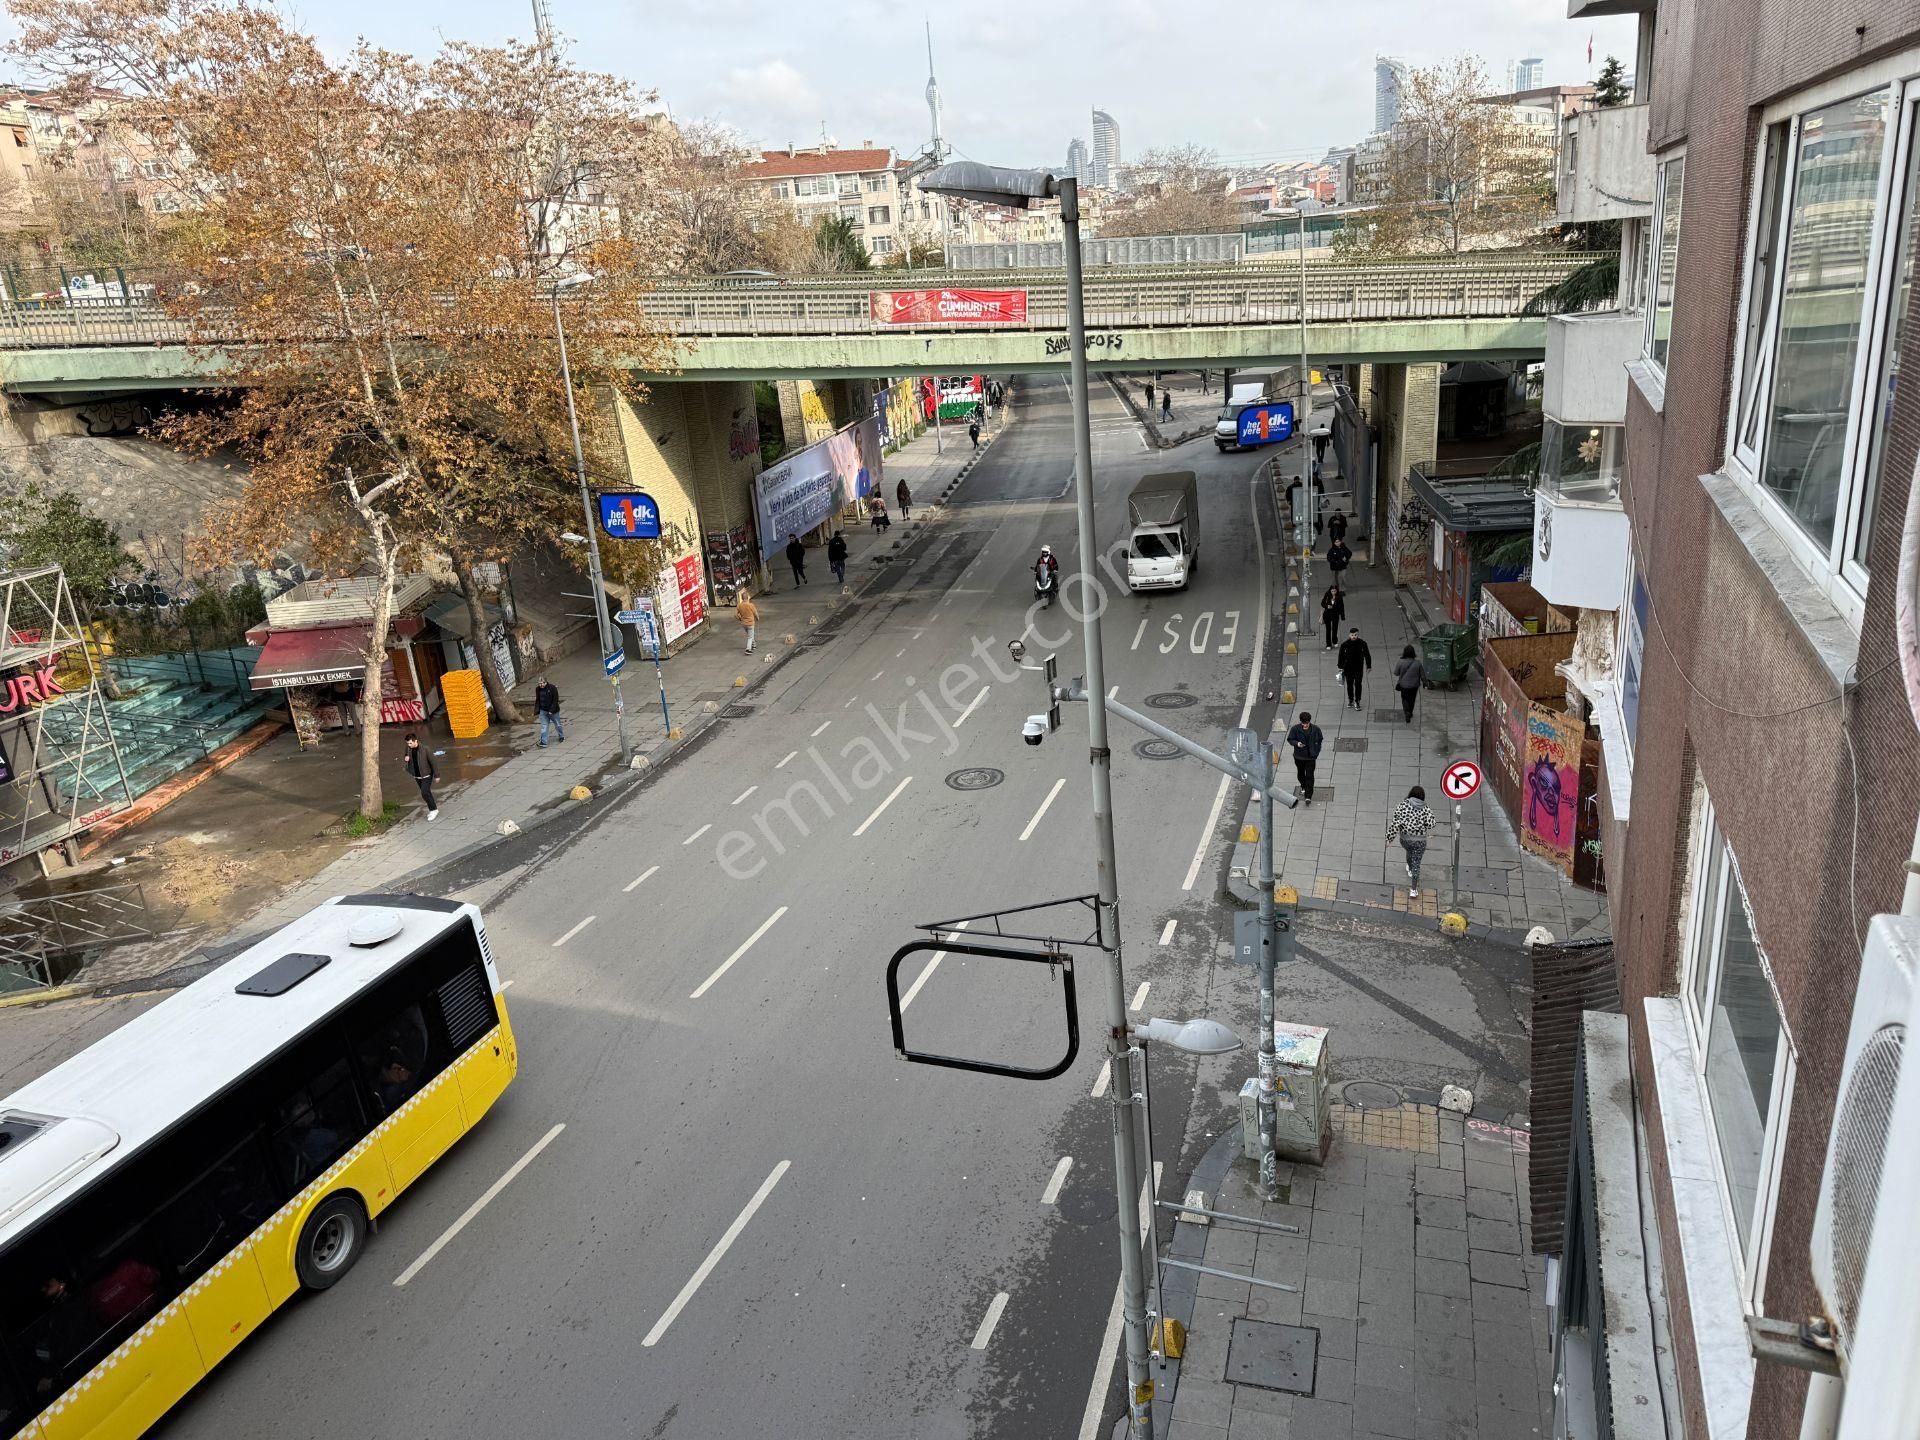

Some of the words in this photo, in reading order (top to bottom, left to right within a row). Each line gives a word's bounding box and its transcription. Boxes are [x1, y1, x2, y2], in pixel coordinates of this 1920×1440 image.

[1246, 420, 1261, 429] her
[1242, 427, 1261, 437] yere
[610, 509, 625, 519] her
[607, 518, 627, 528] yere
[272, 676, 305, 687] İSTANBUL
[306, 673, 326, 683] HALK
[326, 671, 352, 682] EKMEK
